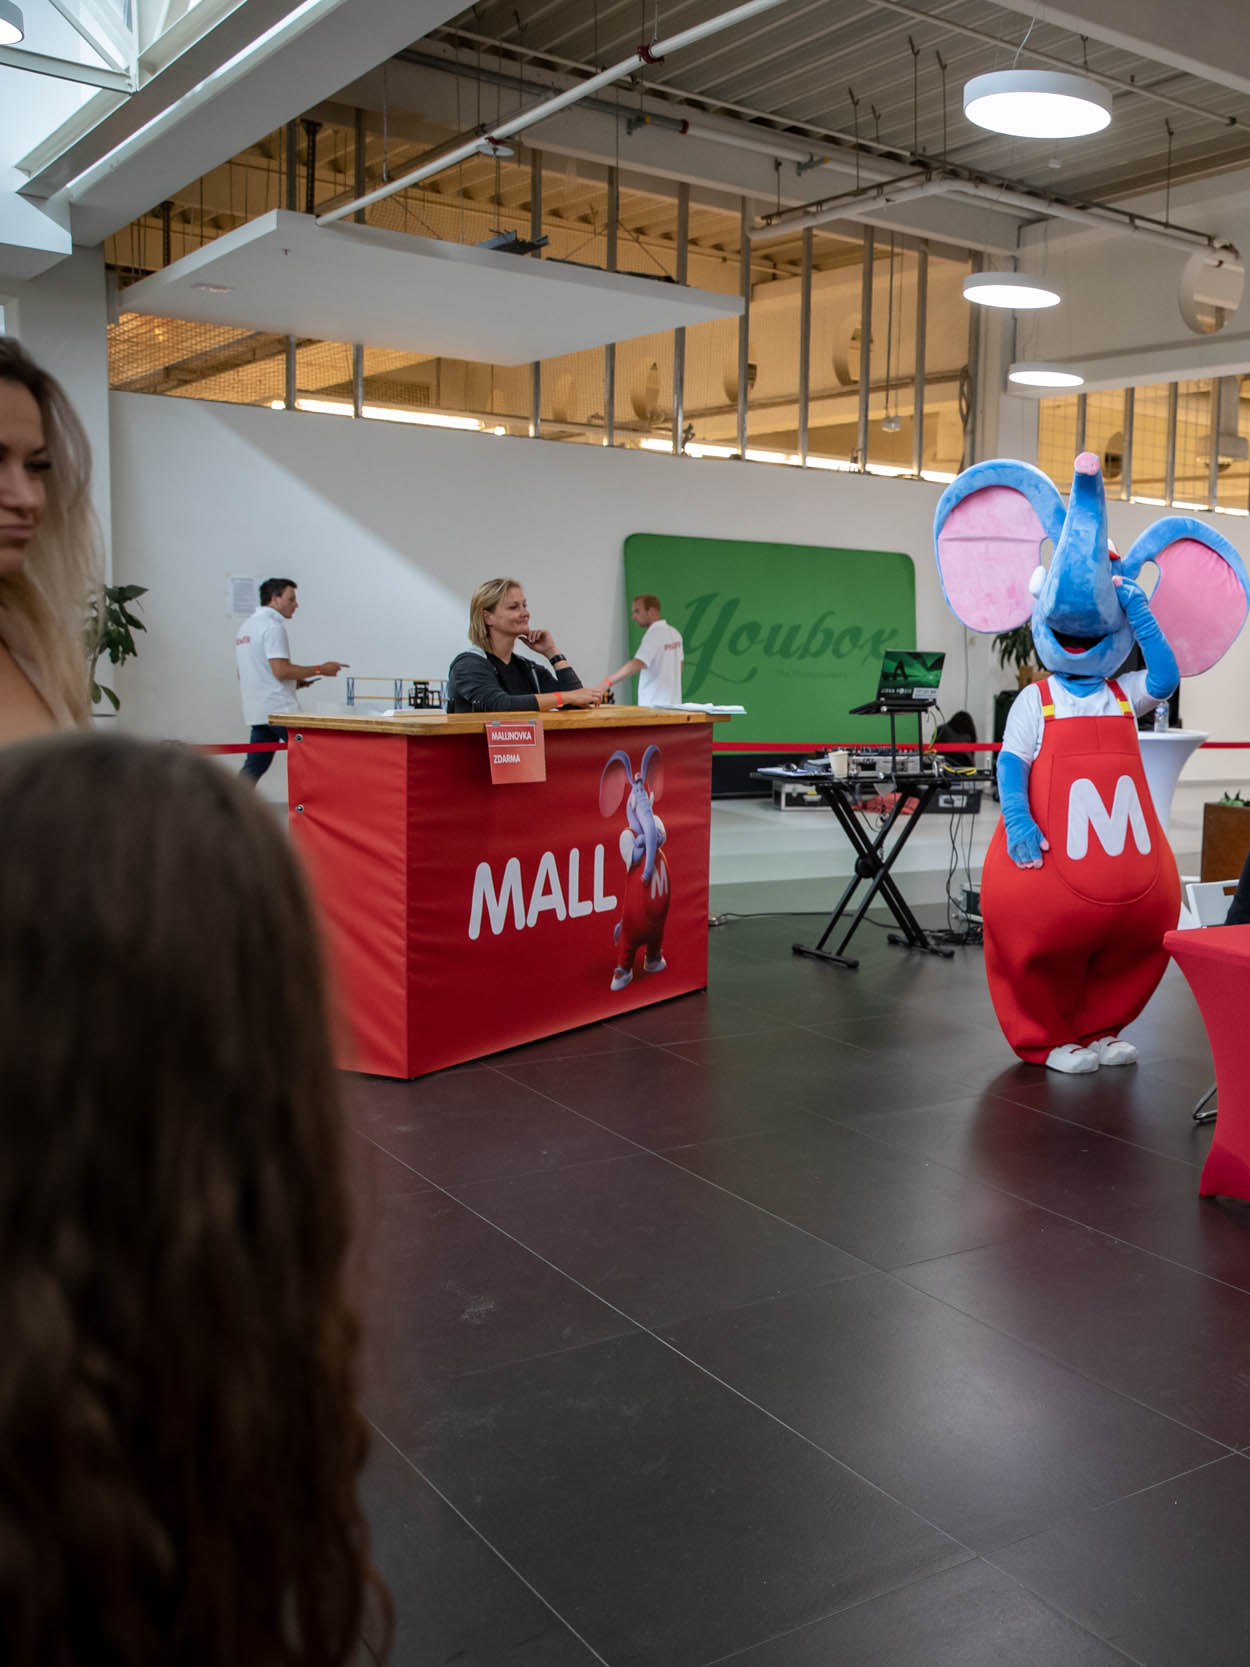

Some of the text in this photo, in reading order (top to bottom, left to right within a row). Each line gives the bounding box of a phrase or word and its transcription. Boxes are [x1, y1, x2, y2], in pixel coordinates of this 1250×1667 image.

[683, 592, 899, 699] Youbox
[492, 731, 532, 741] MALLINOVKA
[493, 754, 521, 764] ZDARMA
[1066, 774, 1152, 860] M
[468, 843, 618, 941] MALL
